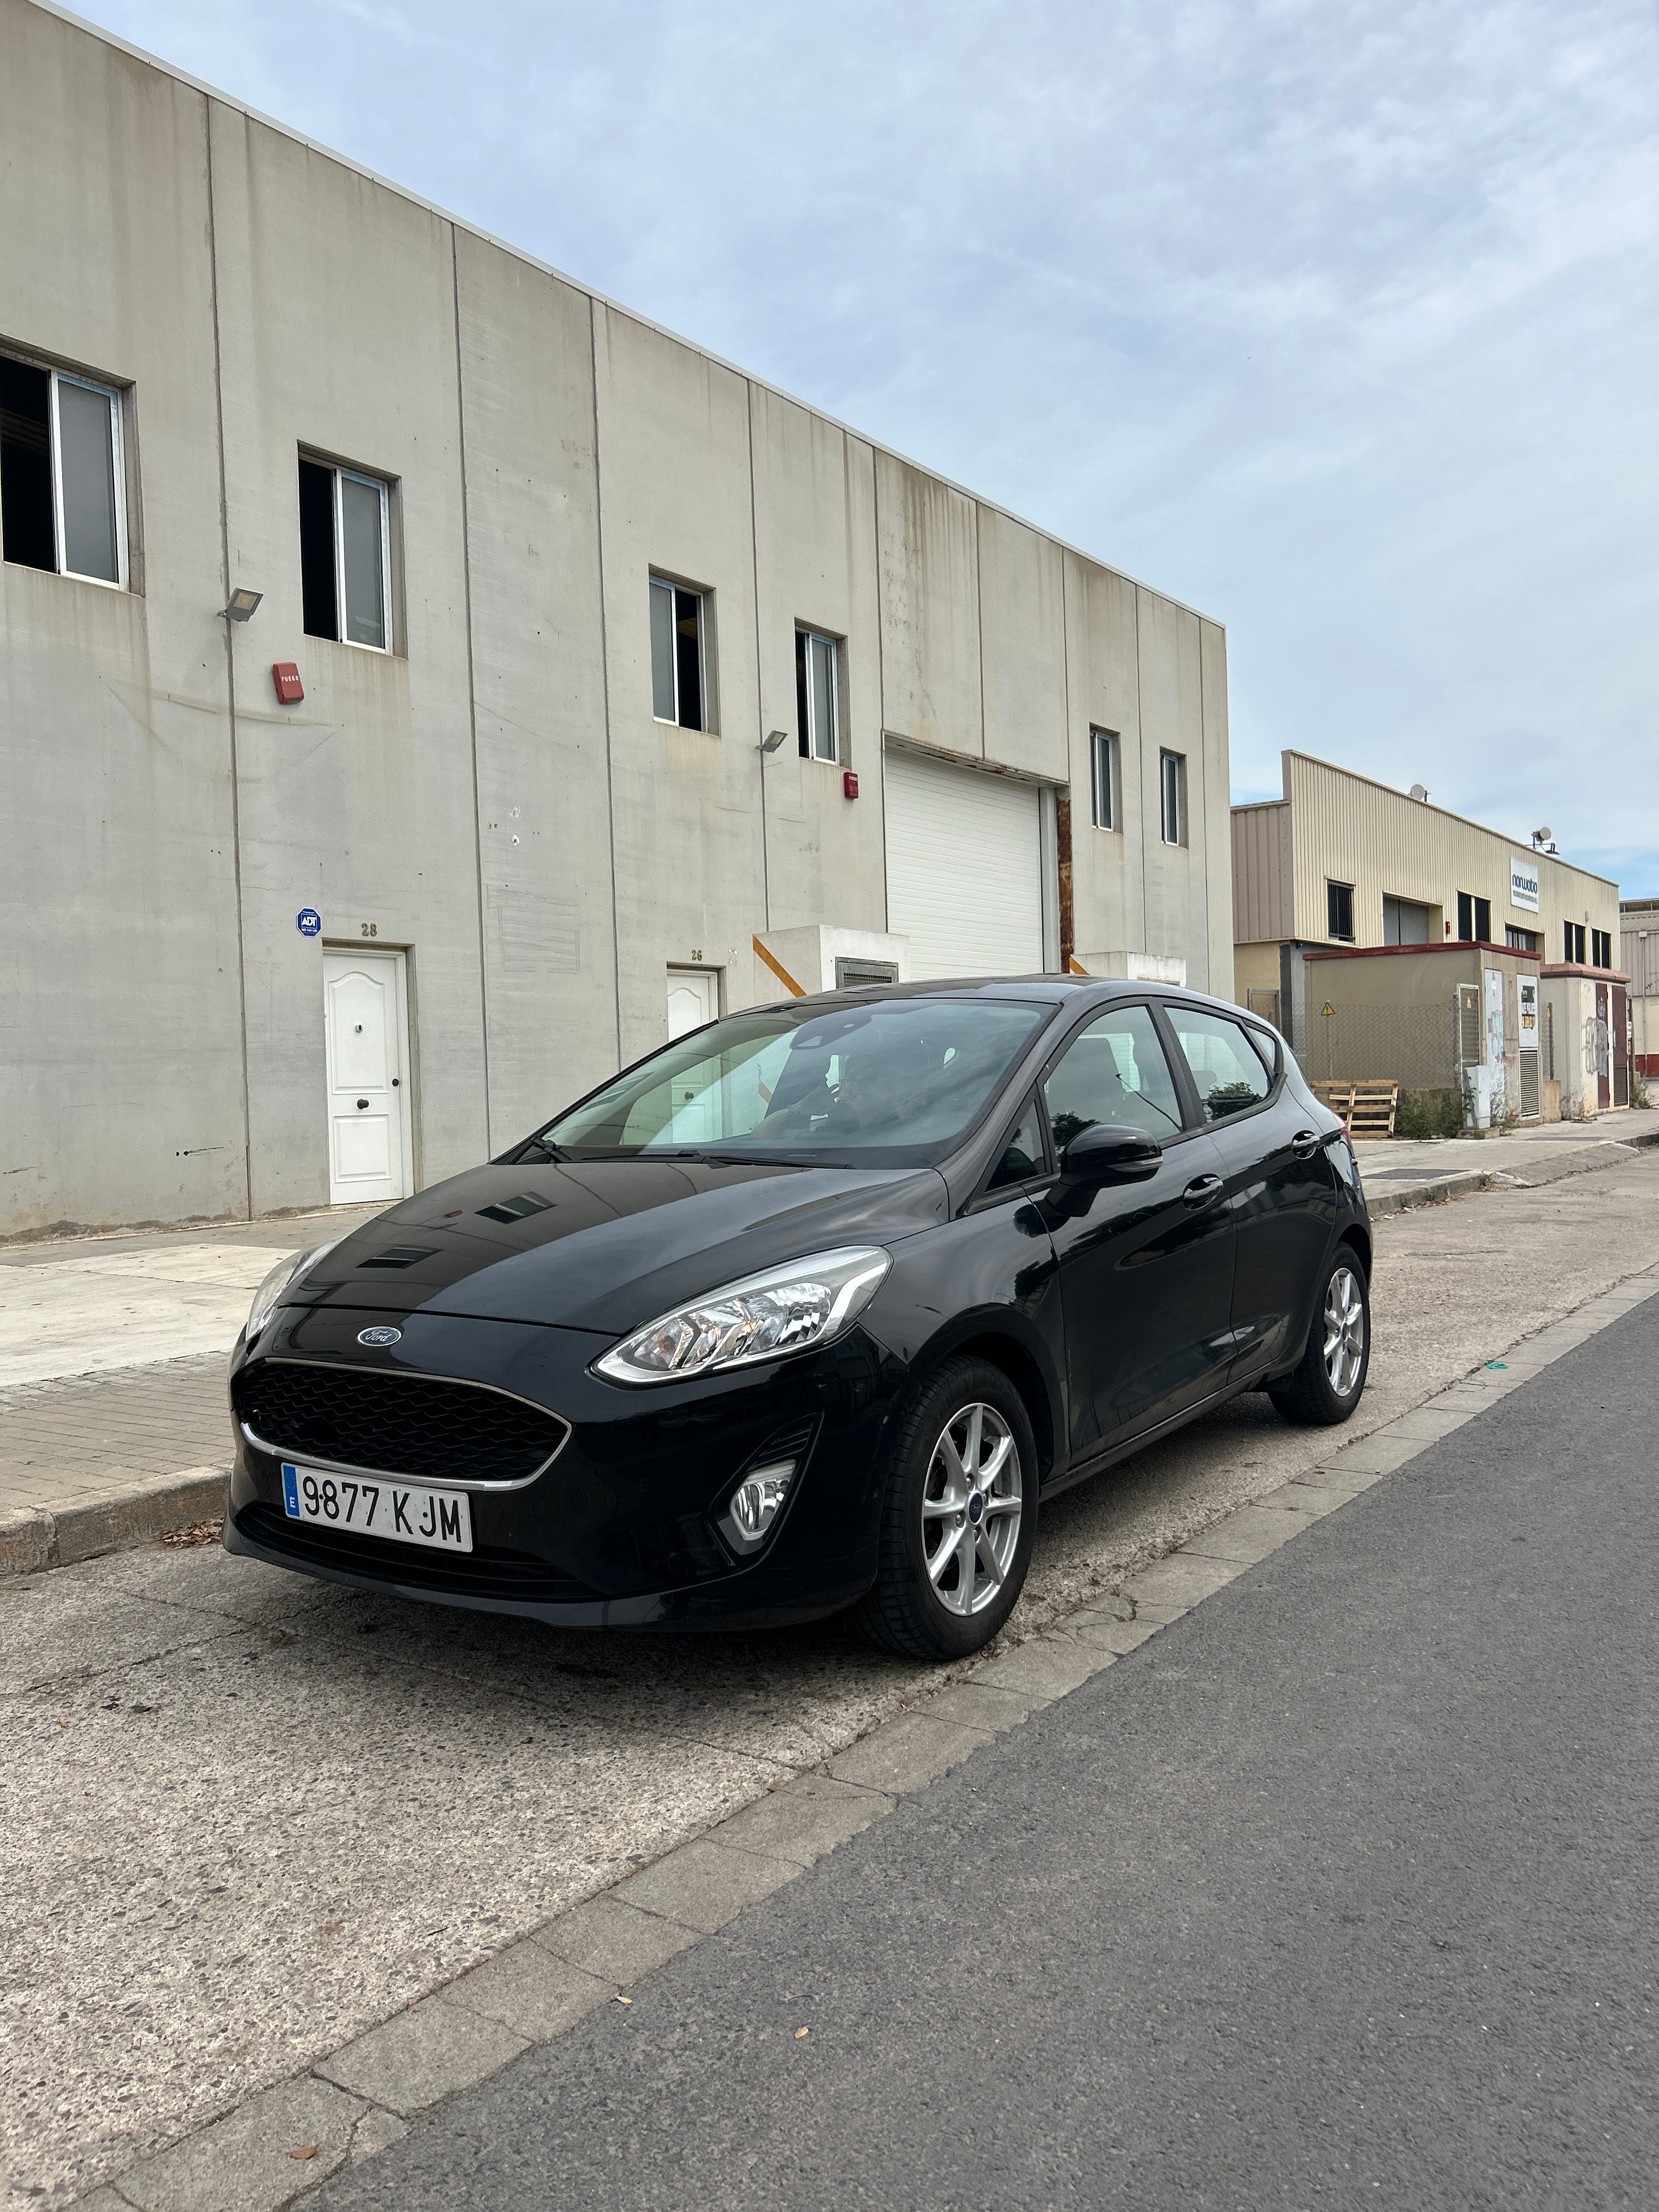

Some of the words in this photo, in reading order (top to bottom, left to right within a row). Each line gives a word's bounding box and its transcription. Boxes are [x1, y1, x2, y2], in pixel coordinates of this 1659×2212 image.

[302, 916, 317, 927] ADT
[362, 922, 377, 937] 28
[691, 949, 703, 961] 26
[365, 1329, 392, 1342] Ford
[289, 1496, 296, 1509] E
[302, 1475, 380, 1527] 9877
[392, 1490, 462, 1543] KJM
